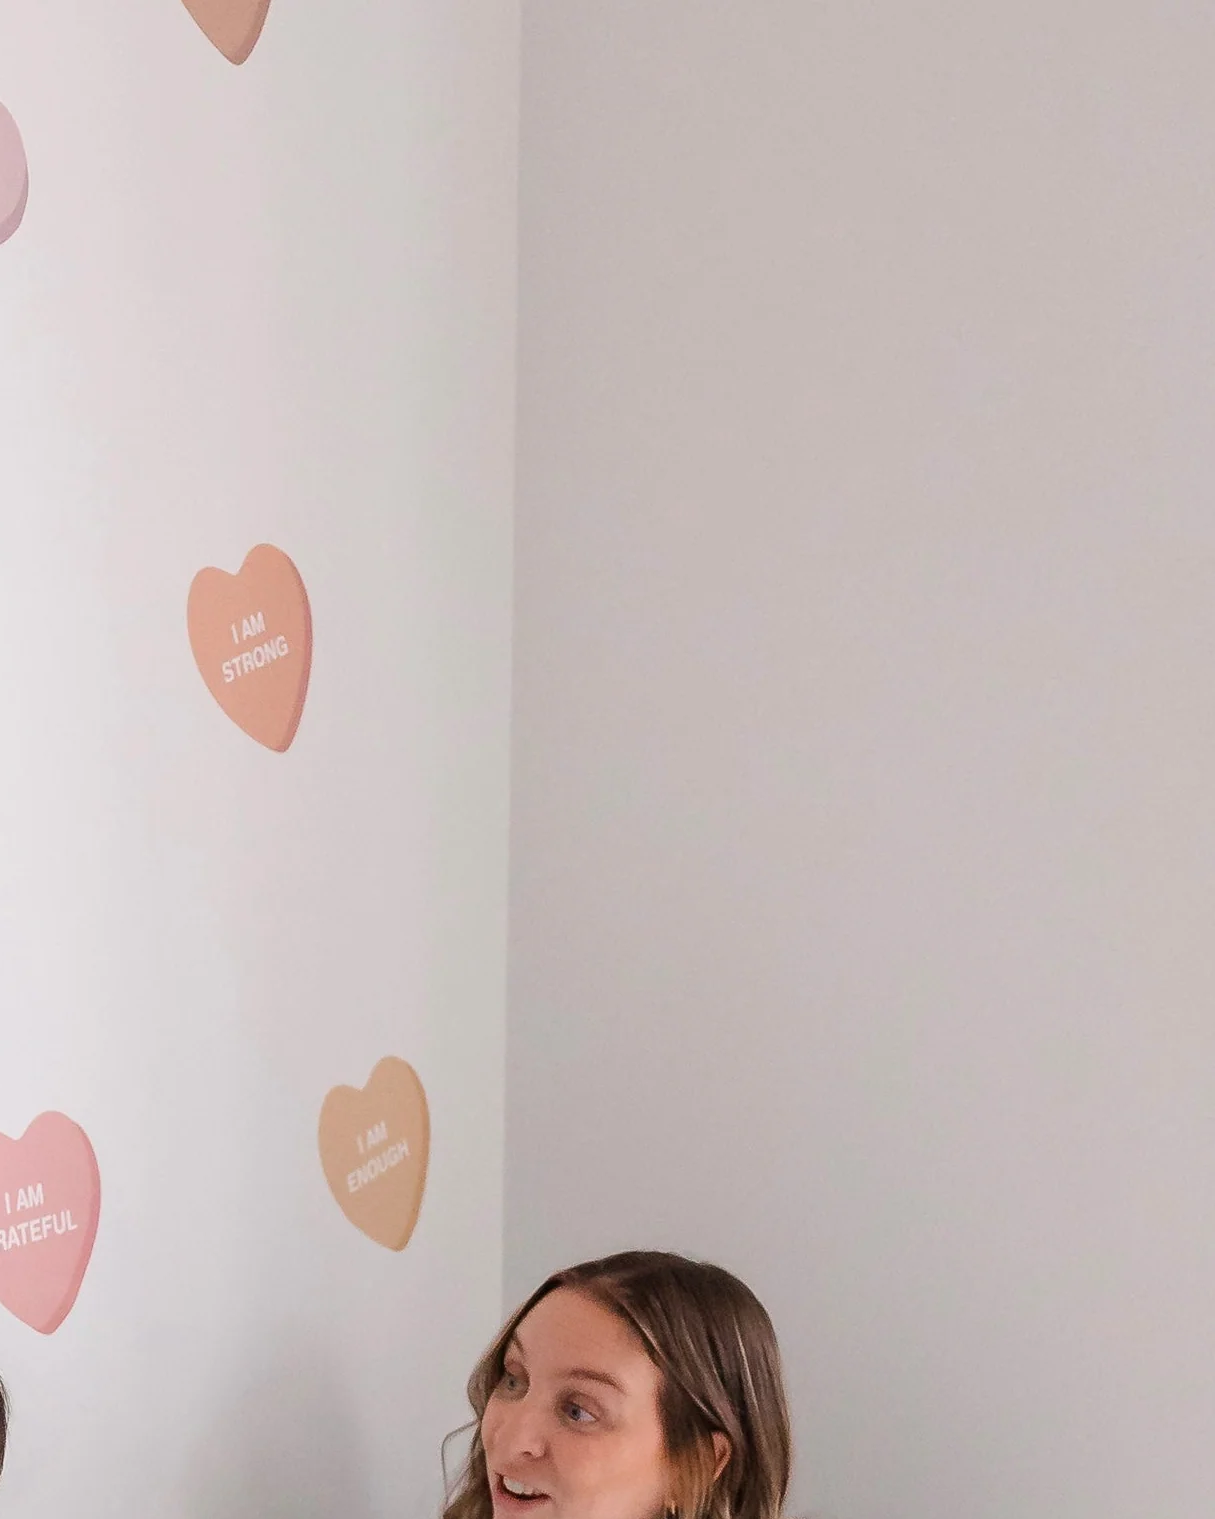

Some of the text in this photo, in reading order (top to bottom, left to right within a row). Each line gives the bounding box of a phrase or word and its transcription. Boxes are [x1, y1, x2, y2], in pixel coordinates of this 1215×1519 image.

[231, 611, 266, 645] I AM
[221, 635, 289, 683] STRONG
[366, 1119, 389, 1149] AM
[346, 1138, 411, 1194] ENOUGH
[4, 1182, 45, 1215] I AM
